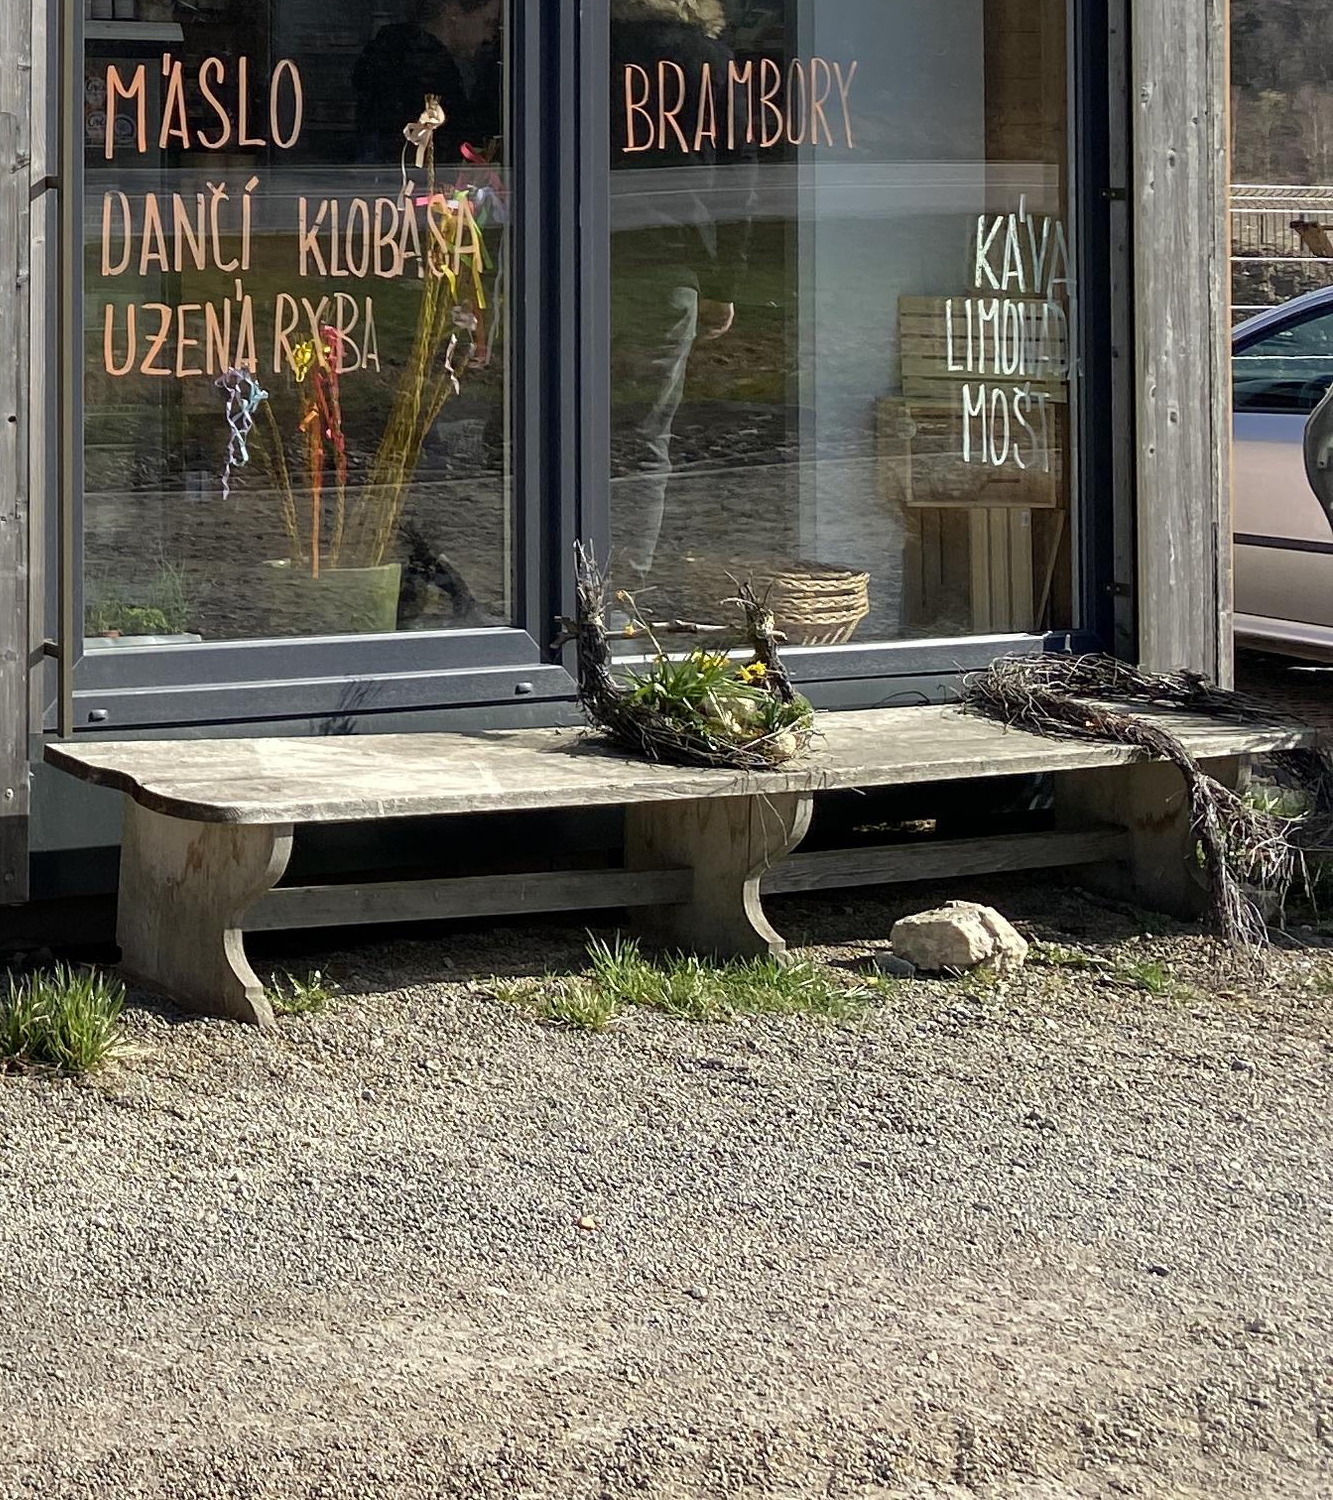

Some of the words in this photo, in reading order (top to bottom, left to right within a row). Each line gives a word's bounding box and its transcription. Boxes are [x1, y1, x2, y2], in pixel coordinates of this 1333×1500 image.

[104, 53, 304, 159] MÁSLO
[622, 57, 858, 153] BRAMBORY
[101, 175, 260, 277] DANČÍ
[298, 179, 483, 279] KLOBÁSA
[974, 193, 1077, 300] KÁVA
[102, 278, 258, 378] UZENÁ
[273, 292, 381, 375] RYBA
